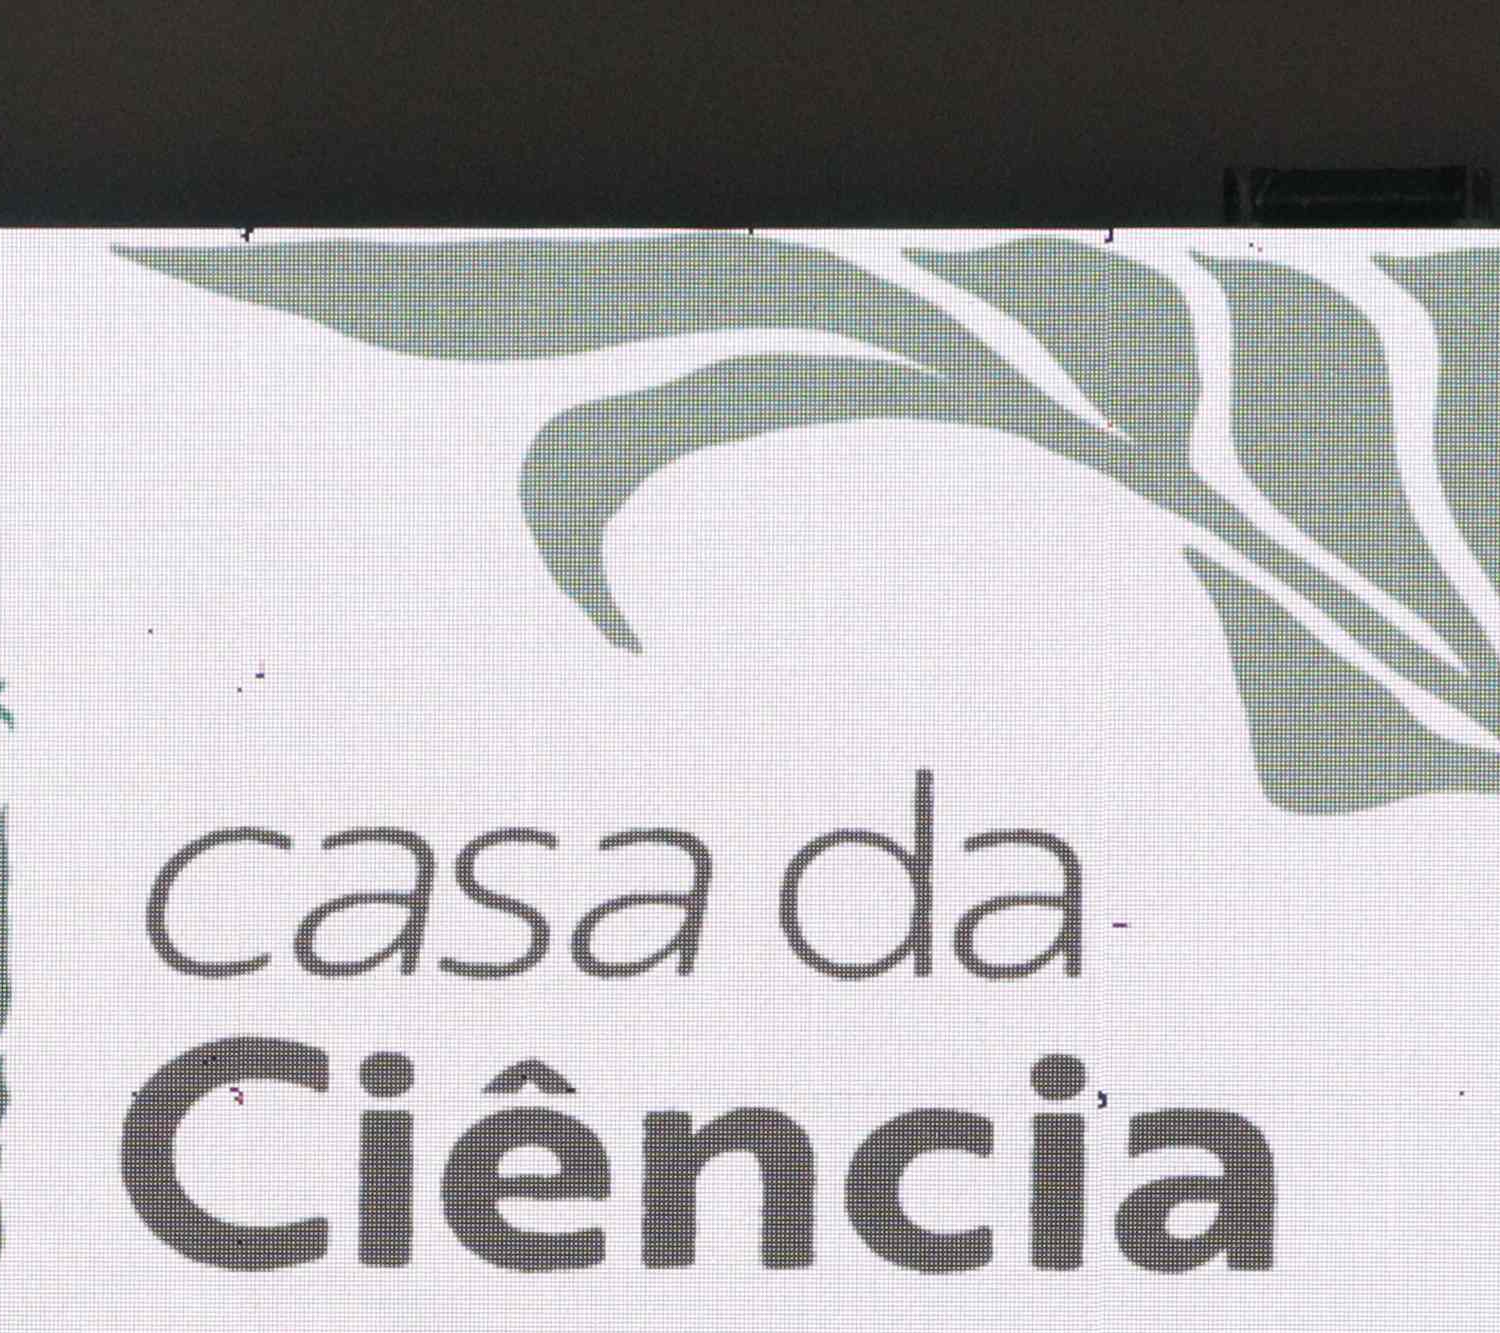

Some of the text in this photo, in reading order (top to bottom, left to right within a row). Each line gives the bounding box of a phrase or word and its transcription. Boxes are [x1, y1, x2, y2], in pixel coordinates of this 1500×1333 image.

[145, 768, 1084, 979] casa da
[120, 1034, 1276, 1273] Ciência
